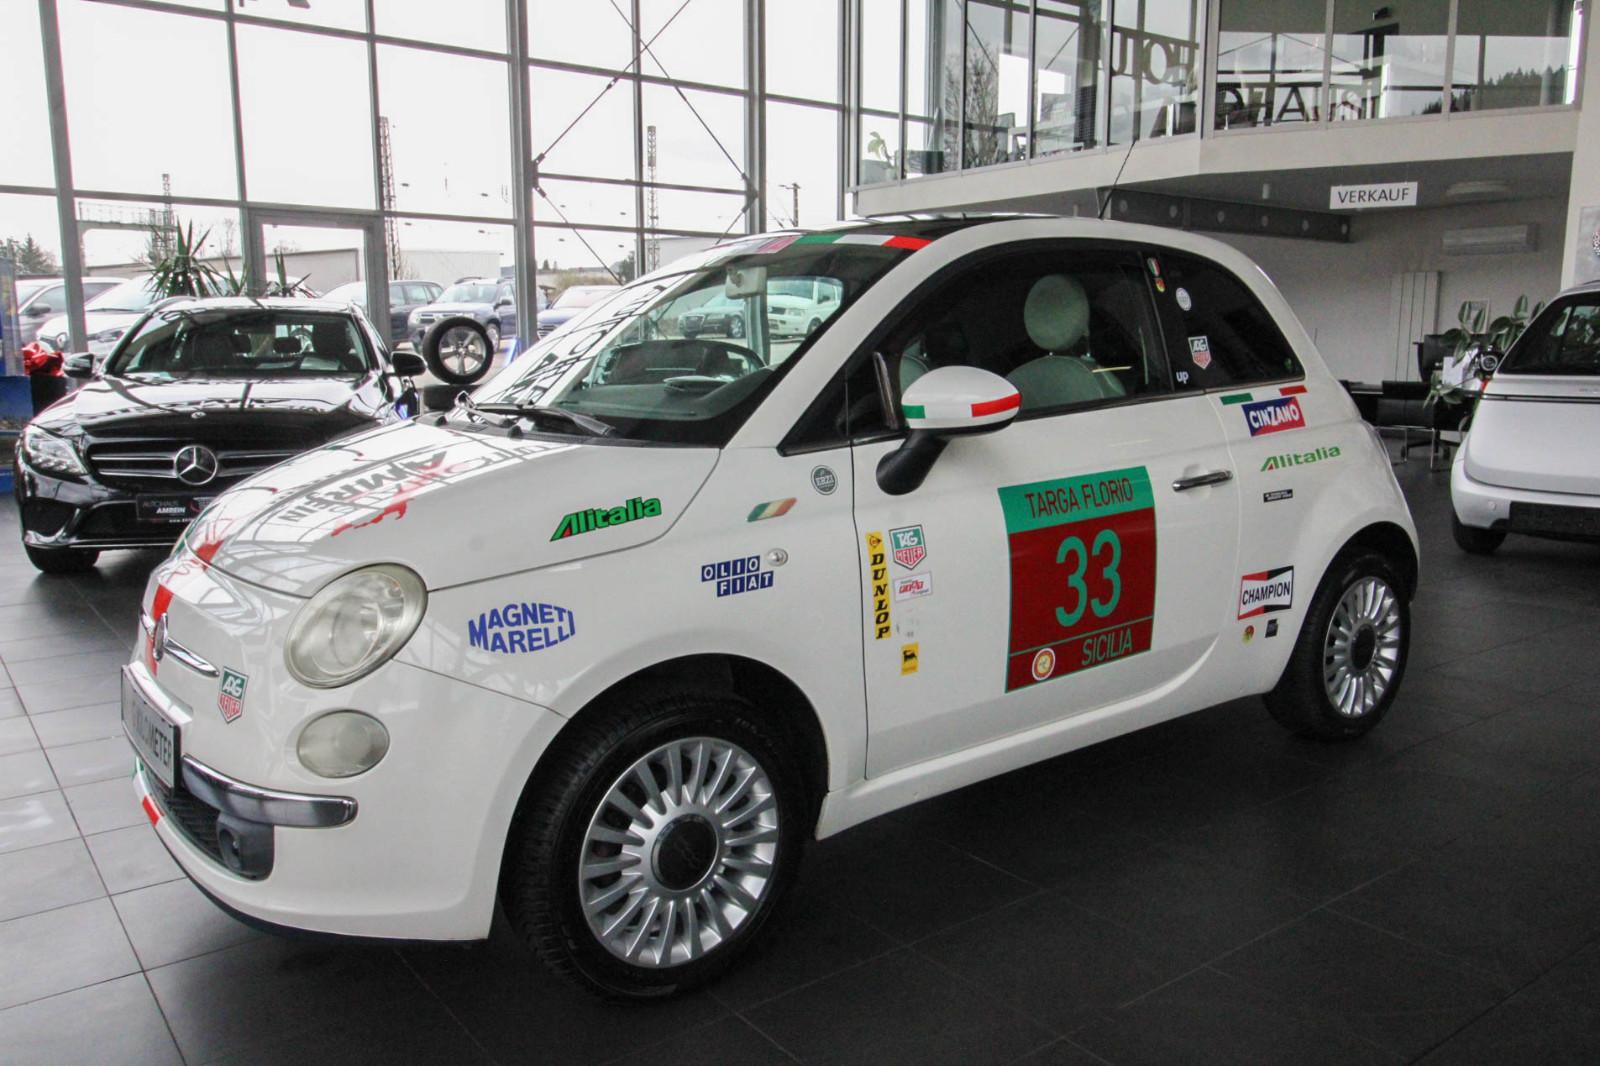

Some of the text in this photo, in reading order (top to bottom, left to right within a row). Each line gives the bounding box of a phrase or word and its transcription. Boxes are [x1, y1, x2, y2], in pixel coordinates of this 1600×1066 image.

[1337, 187, 1410, 203] VERKAUF
[1249, 403, 1301, 429] CINZANO
[1260, 446, 1341, 472] Alitalia
[1024, 477, 1134, 519] TARGA FLORIO
[549, 496, 662, 542] Alitalia
[896, 531, 918, 548] TAG
[703, 558, 759, 580] OLIO
[895, 547, 924, 566] HEUER
[719, 573, 772, 595] FIAT
[1055, 529, 1122, 628] 33
[871, 553, 891, 639] DUNLOP
[1242, 581, 1291, 606] CHAMPION
[468, 603, 576, 640] MAGNETI
[468, 622, 576, 653] MARELLI
[1081, 628, 1133, 666] SICILIA
